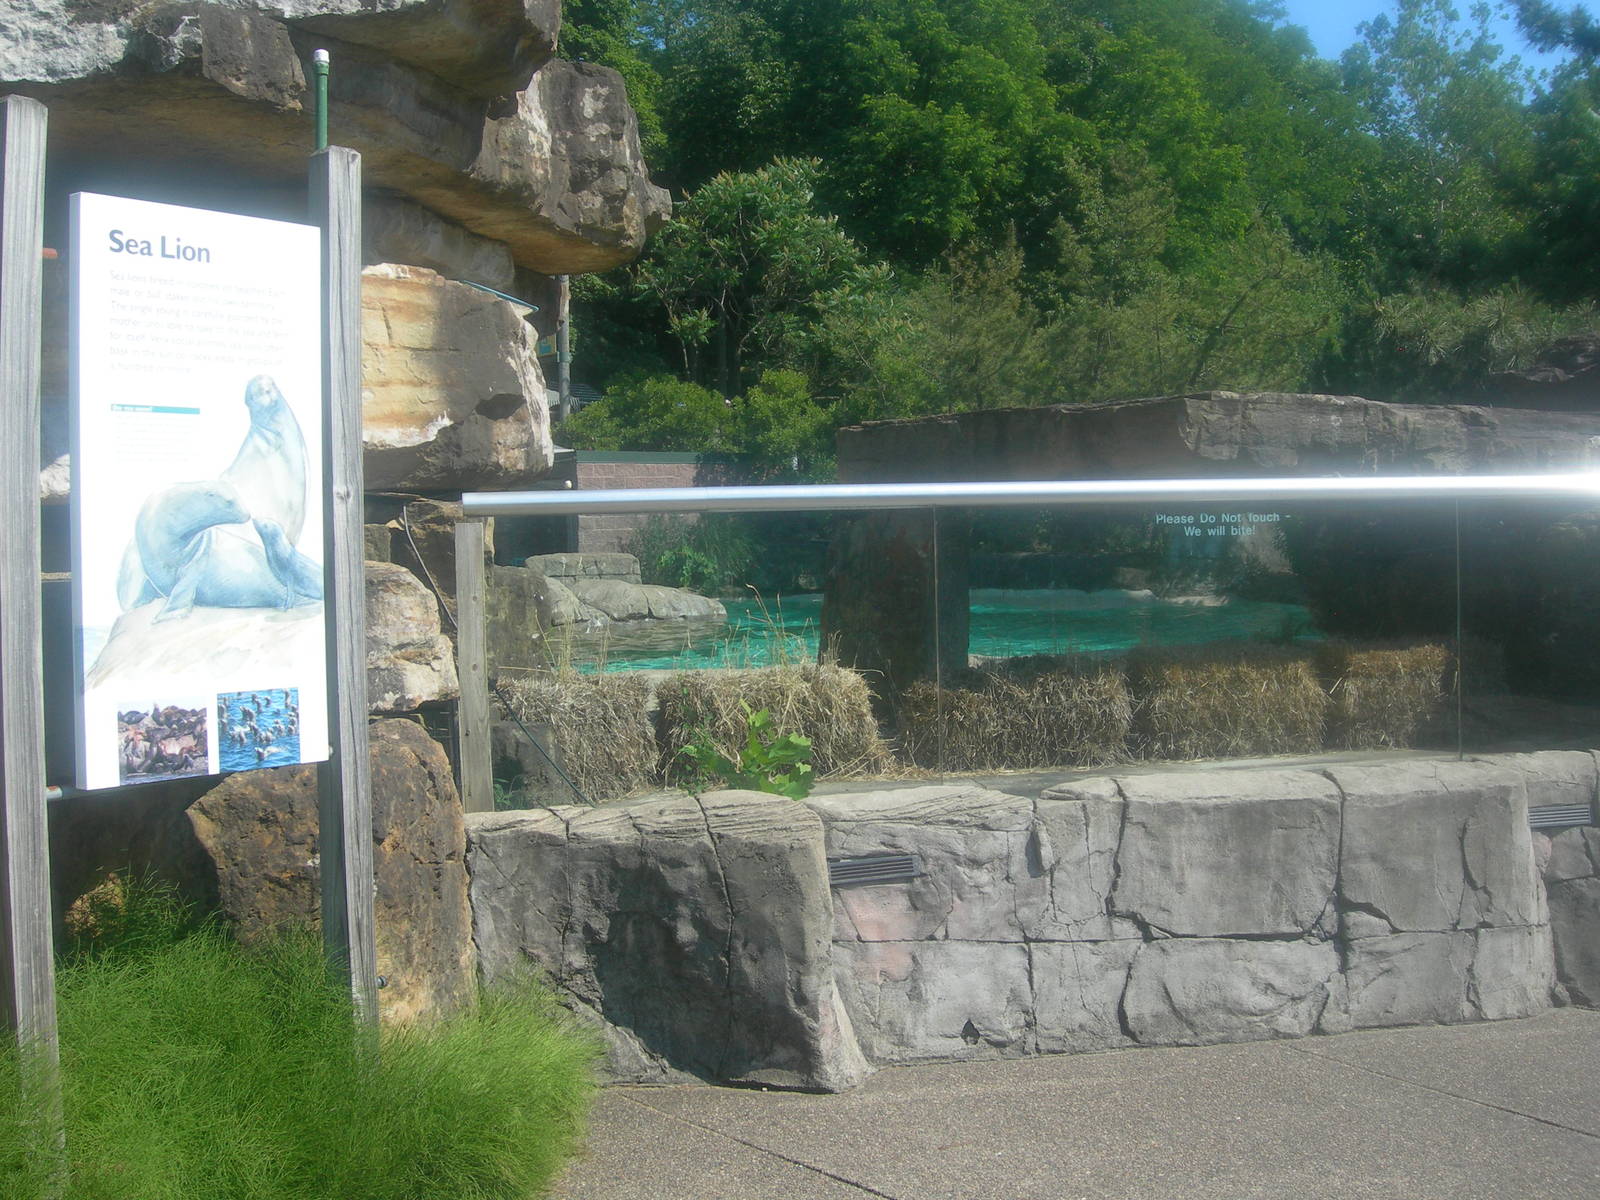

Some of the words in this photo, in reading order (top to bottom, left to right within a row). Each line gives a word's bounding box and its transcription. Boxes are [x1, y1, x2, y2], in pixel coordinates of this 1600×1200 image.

[109, 229, 153, 256] Sea
[161, 235, 210, 263] Lion
[1156, 513, 1194, 524] Please
[1200, 513, 1216, 523] Do
[1222, 513, 1241, 523] Not
[1248, 512, 1280, 522] Touch
[1184, 526, 1201, 536] We
[1207, 526, 1225, 536] will
[1231, 525, 1256, 536] bite!
